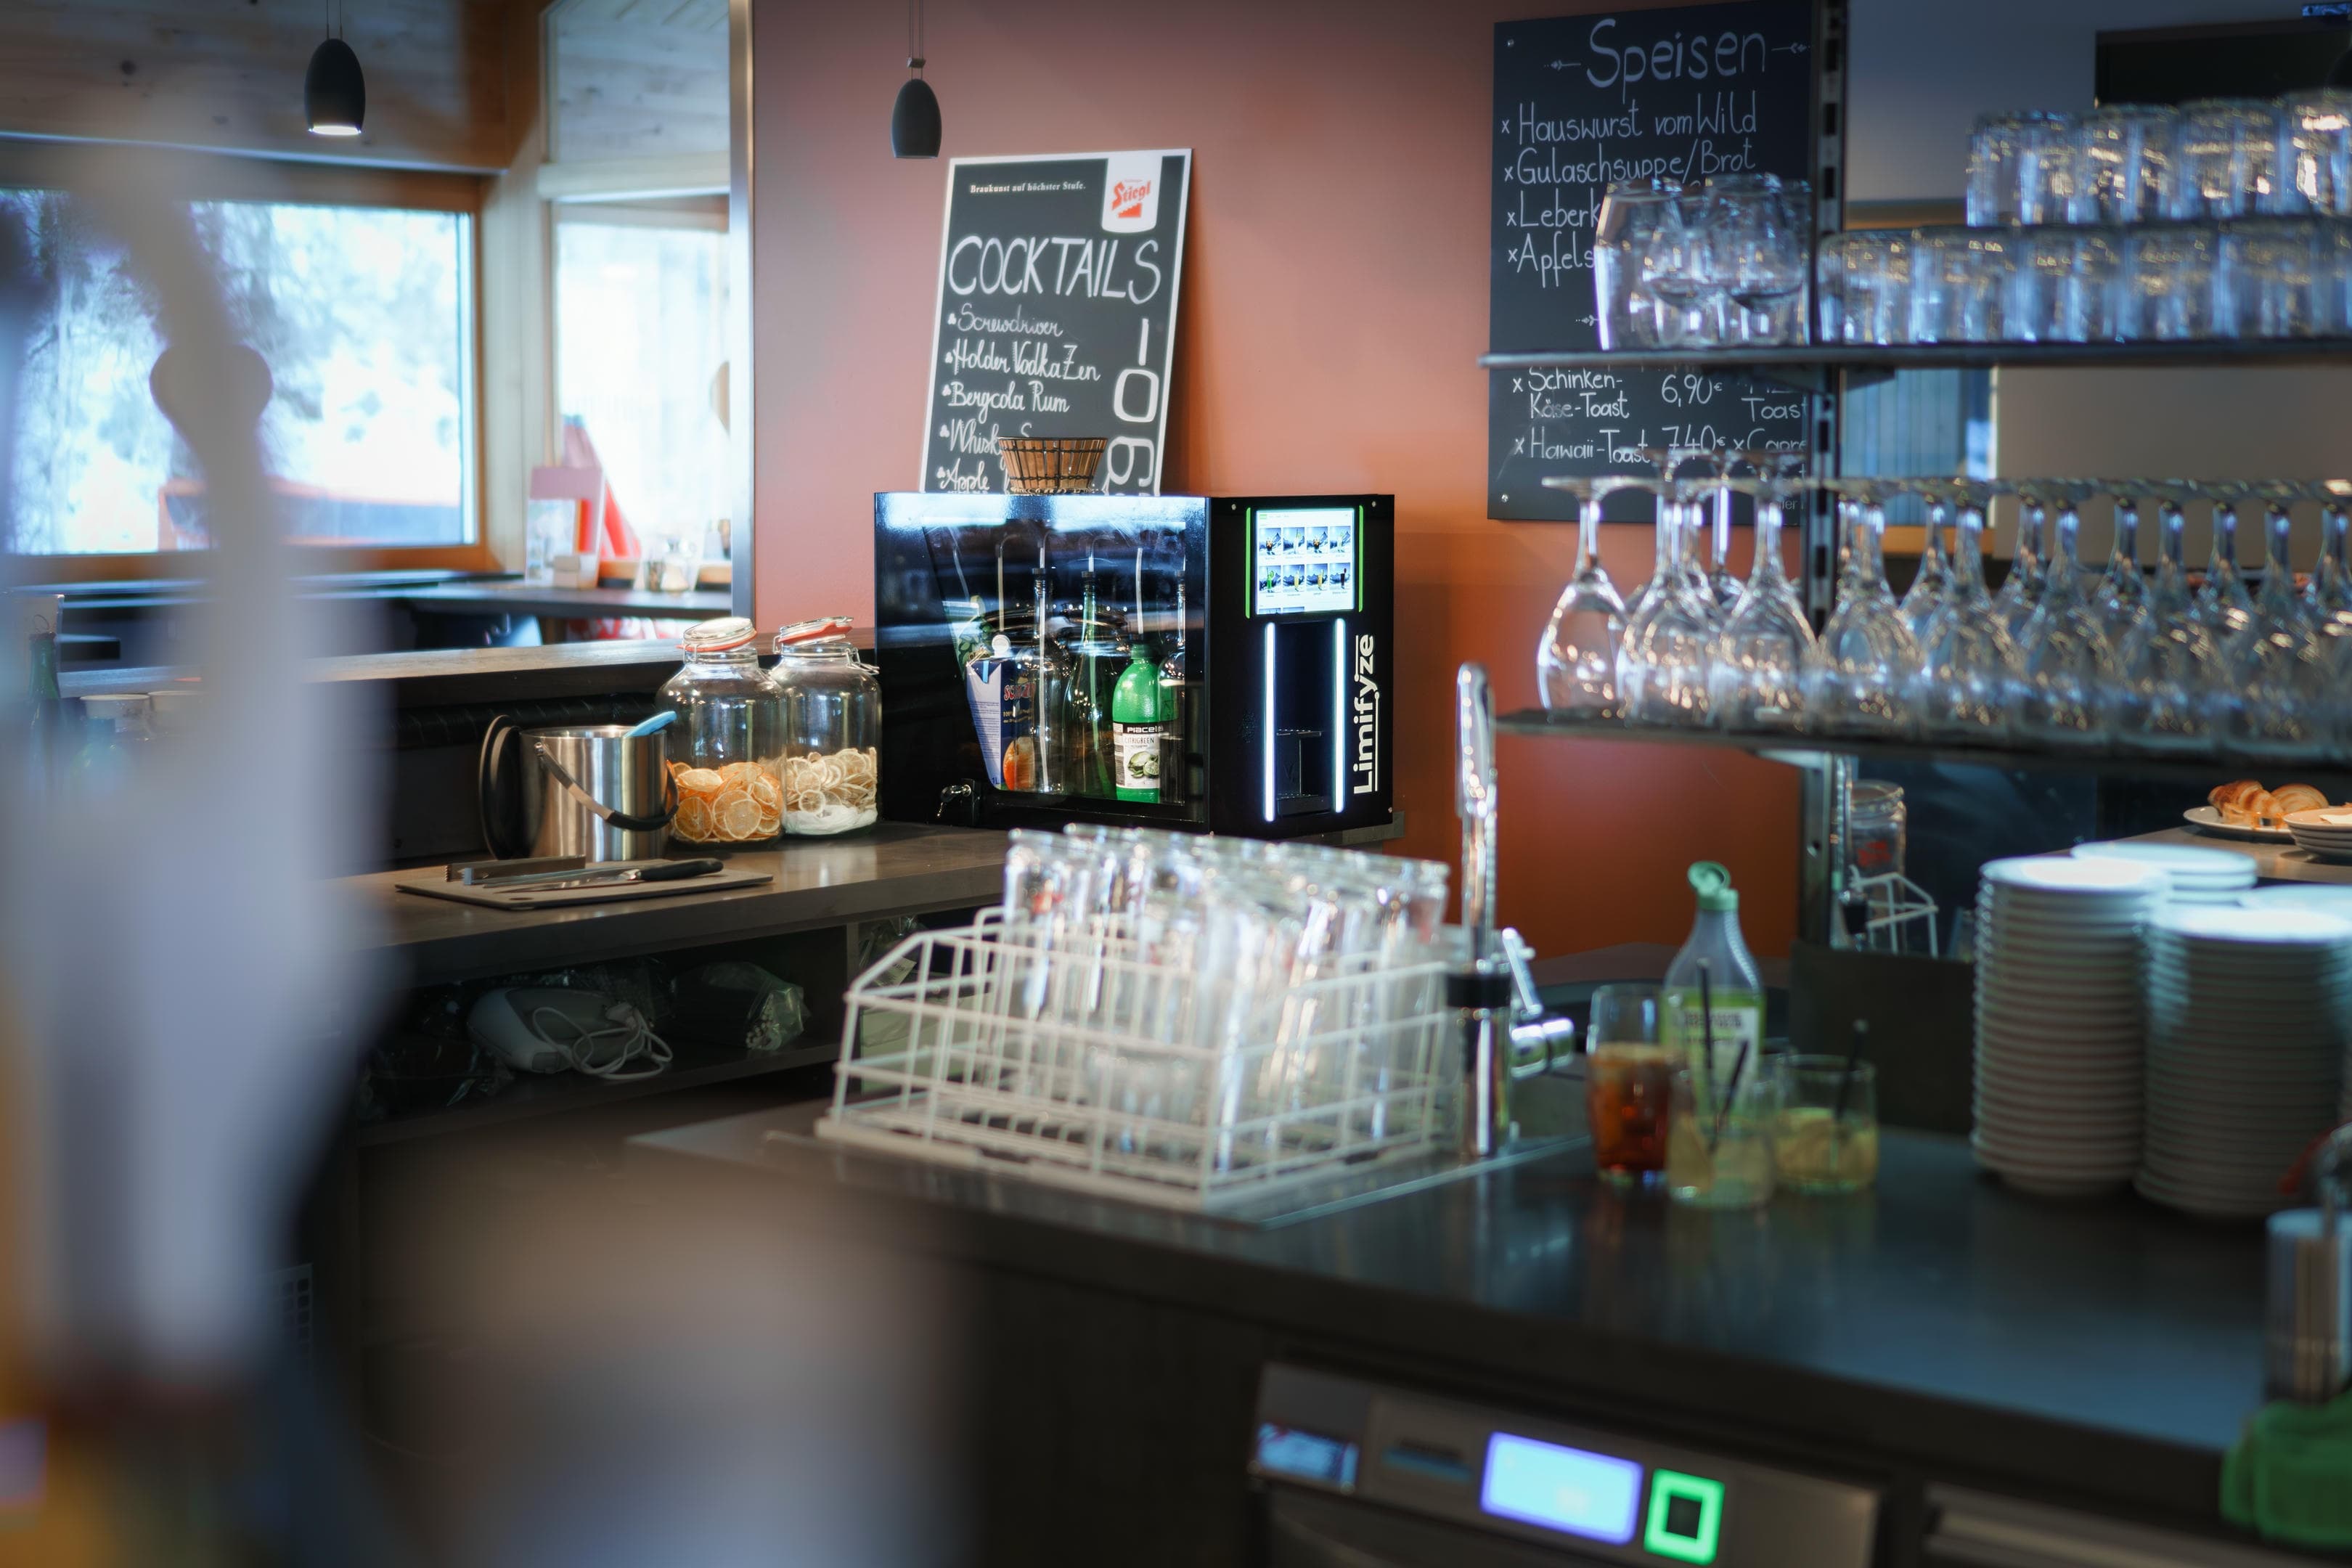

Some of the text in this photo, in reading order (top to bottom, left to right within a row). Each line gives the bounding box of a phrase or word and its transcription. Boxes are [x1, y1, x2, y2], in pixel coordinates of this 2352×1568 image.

[1587, 18, 1765, 105] Speisen
[1519, 90, 1756, 145] Hauswurst vom Wild
[970, 184, 1010, 193] Braukunst
[1012, 183, 1026, 192] auf
[1027, 182, 1061, 191] höchster
[1111, 180, 1151, 211] Stiegl
[949, 235, 1161, 305] COCKTAILS
[957, 303, 1063, 337] Screwdriver
[947, 380, 1070, 424] Bergcola Rum
[940, 458, 990, 491] Apple
[1353, 634, 1379, 794] Limifyze
